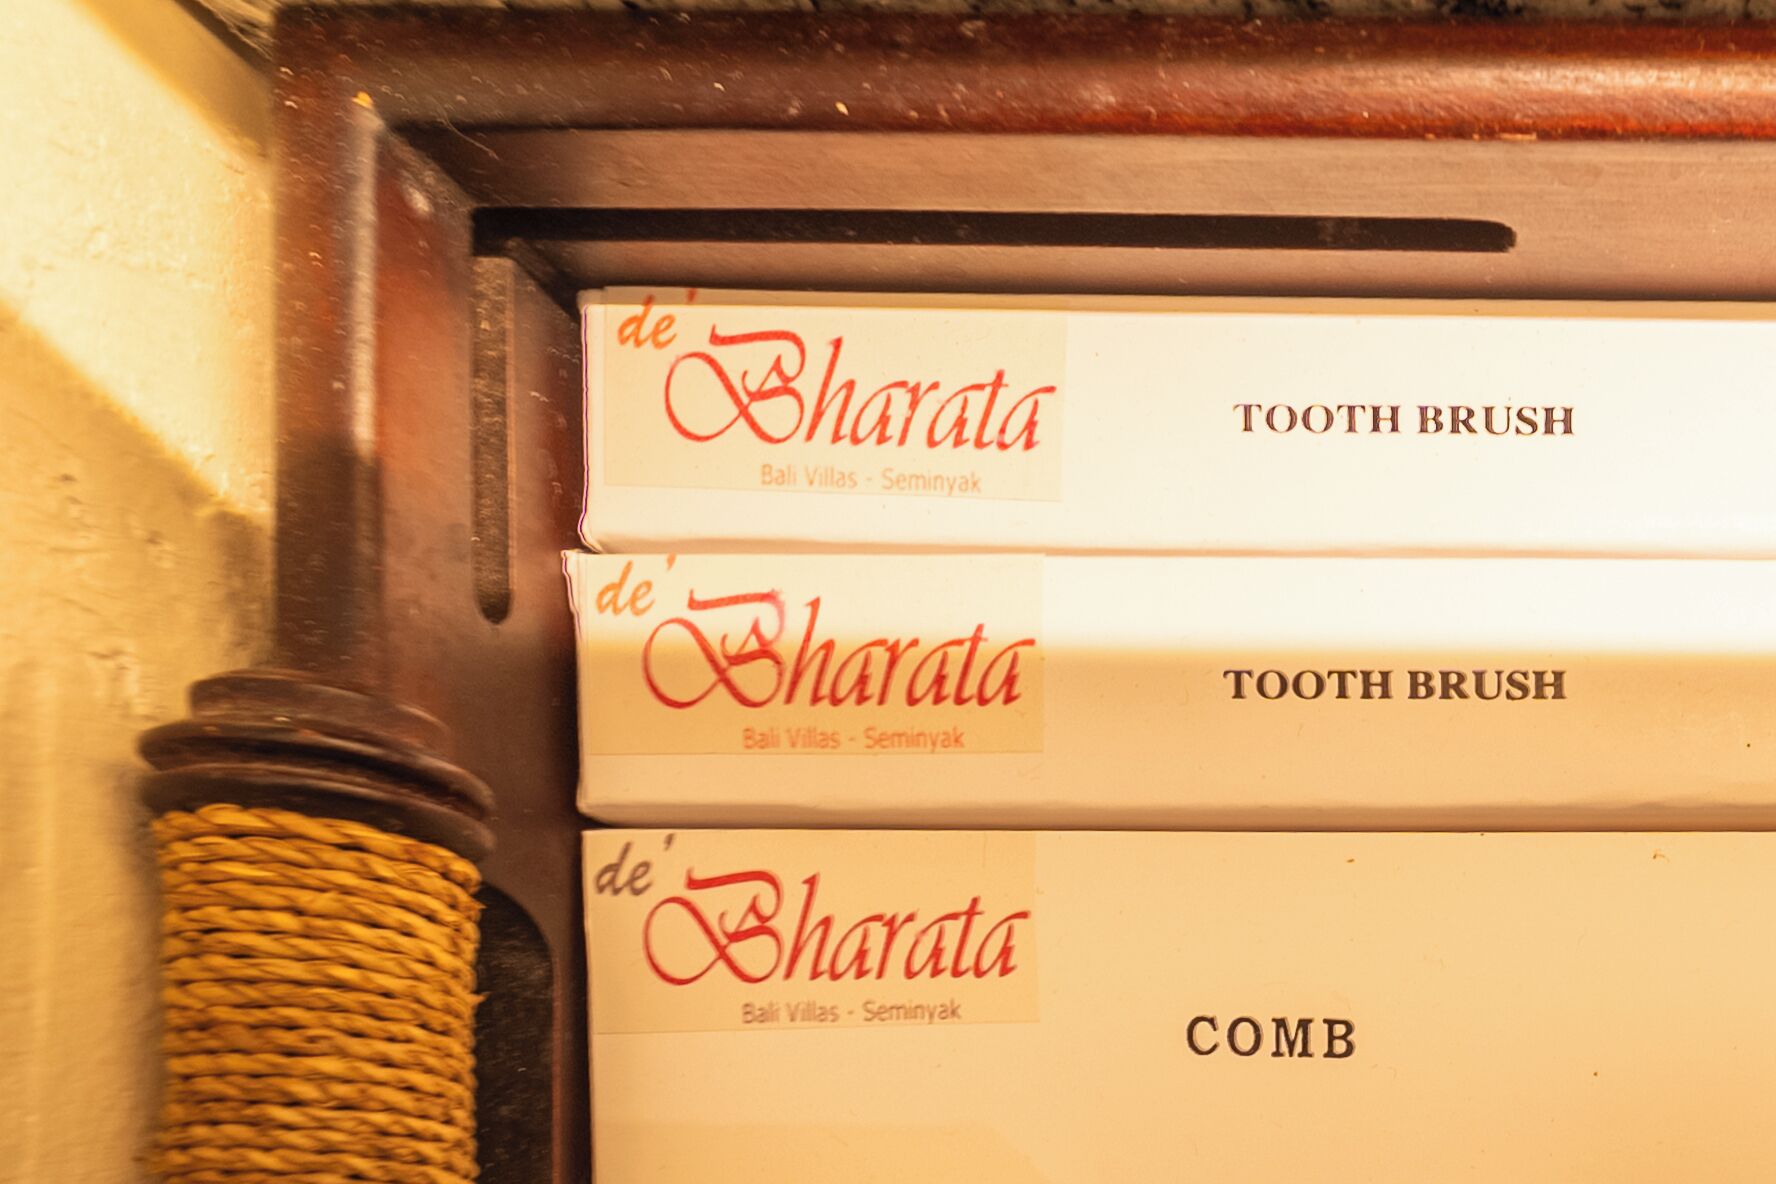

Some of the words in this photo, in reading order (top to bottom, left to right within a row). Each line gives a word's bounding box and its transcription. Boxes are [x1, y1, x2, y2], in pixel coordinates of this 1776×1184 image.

[665, 324, 1057, 451] Bharata
[1233, 404, 1402, 434] TOOTH
[1416, 405, 1575, 436] BRUSH
[761, 464, 797, 486] Bali
[804, 466, 858, 490] Villas
[881, 468, 982, 496] Seminyak
[642, 588, 1036, 709] Bharata
[1223, 669, 1394, 700] TOOTH
[1407, 669, 1567, 700] BRUSH
[743, 727, 779, 749] Bali
[786, 727, 840, 750] Villas
[864, 726, 965, 753] Seminyak
[644, 867, 1031, 986] Bharata
[743, 1002, 779, 1024] Bali
[785, 1001, 839, 1023] Villas
[863, 1000, 962, 1025] Seminyak
[1186, 1015, 1356, 1059] COMB
